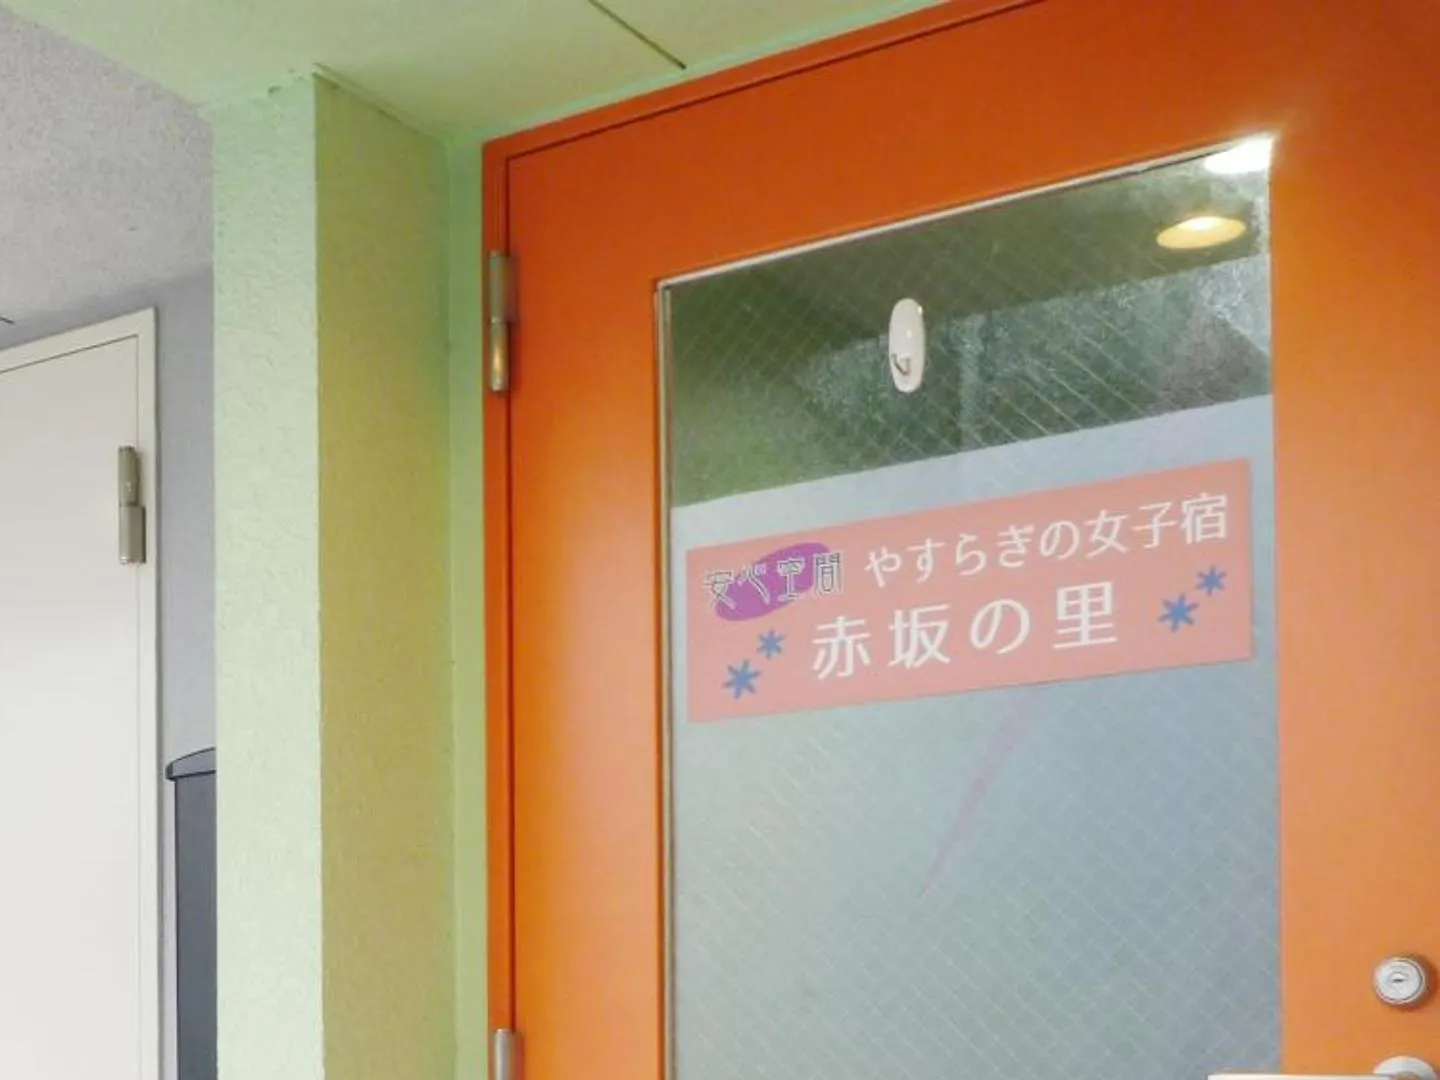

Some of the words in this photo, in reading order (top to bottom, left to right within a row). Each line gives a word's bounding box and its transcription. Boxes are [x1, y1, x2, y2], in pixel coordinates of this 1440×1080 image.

[863, 492, 1229, 588] やすらぎの女子宿
[811, 580, 1119, 679] 赤坂の里
